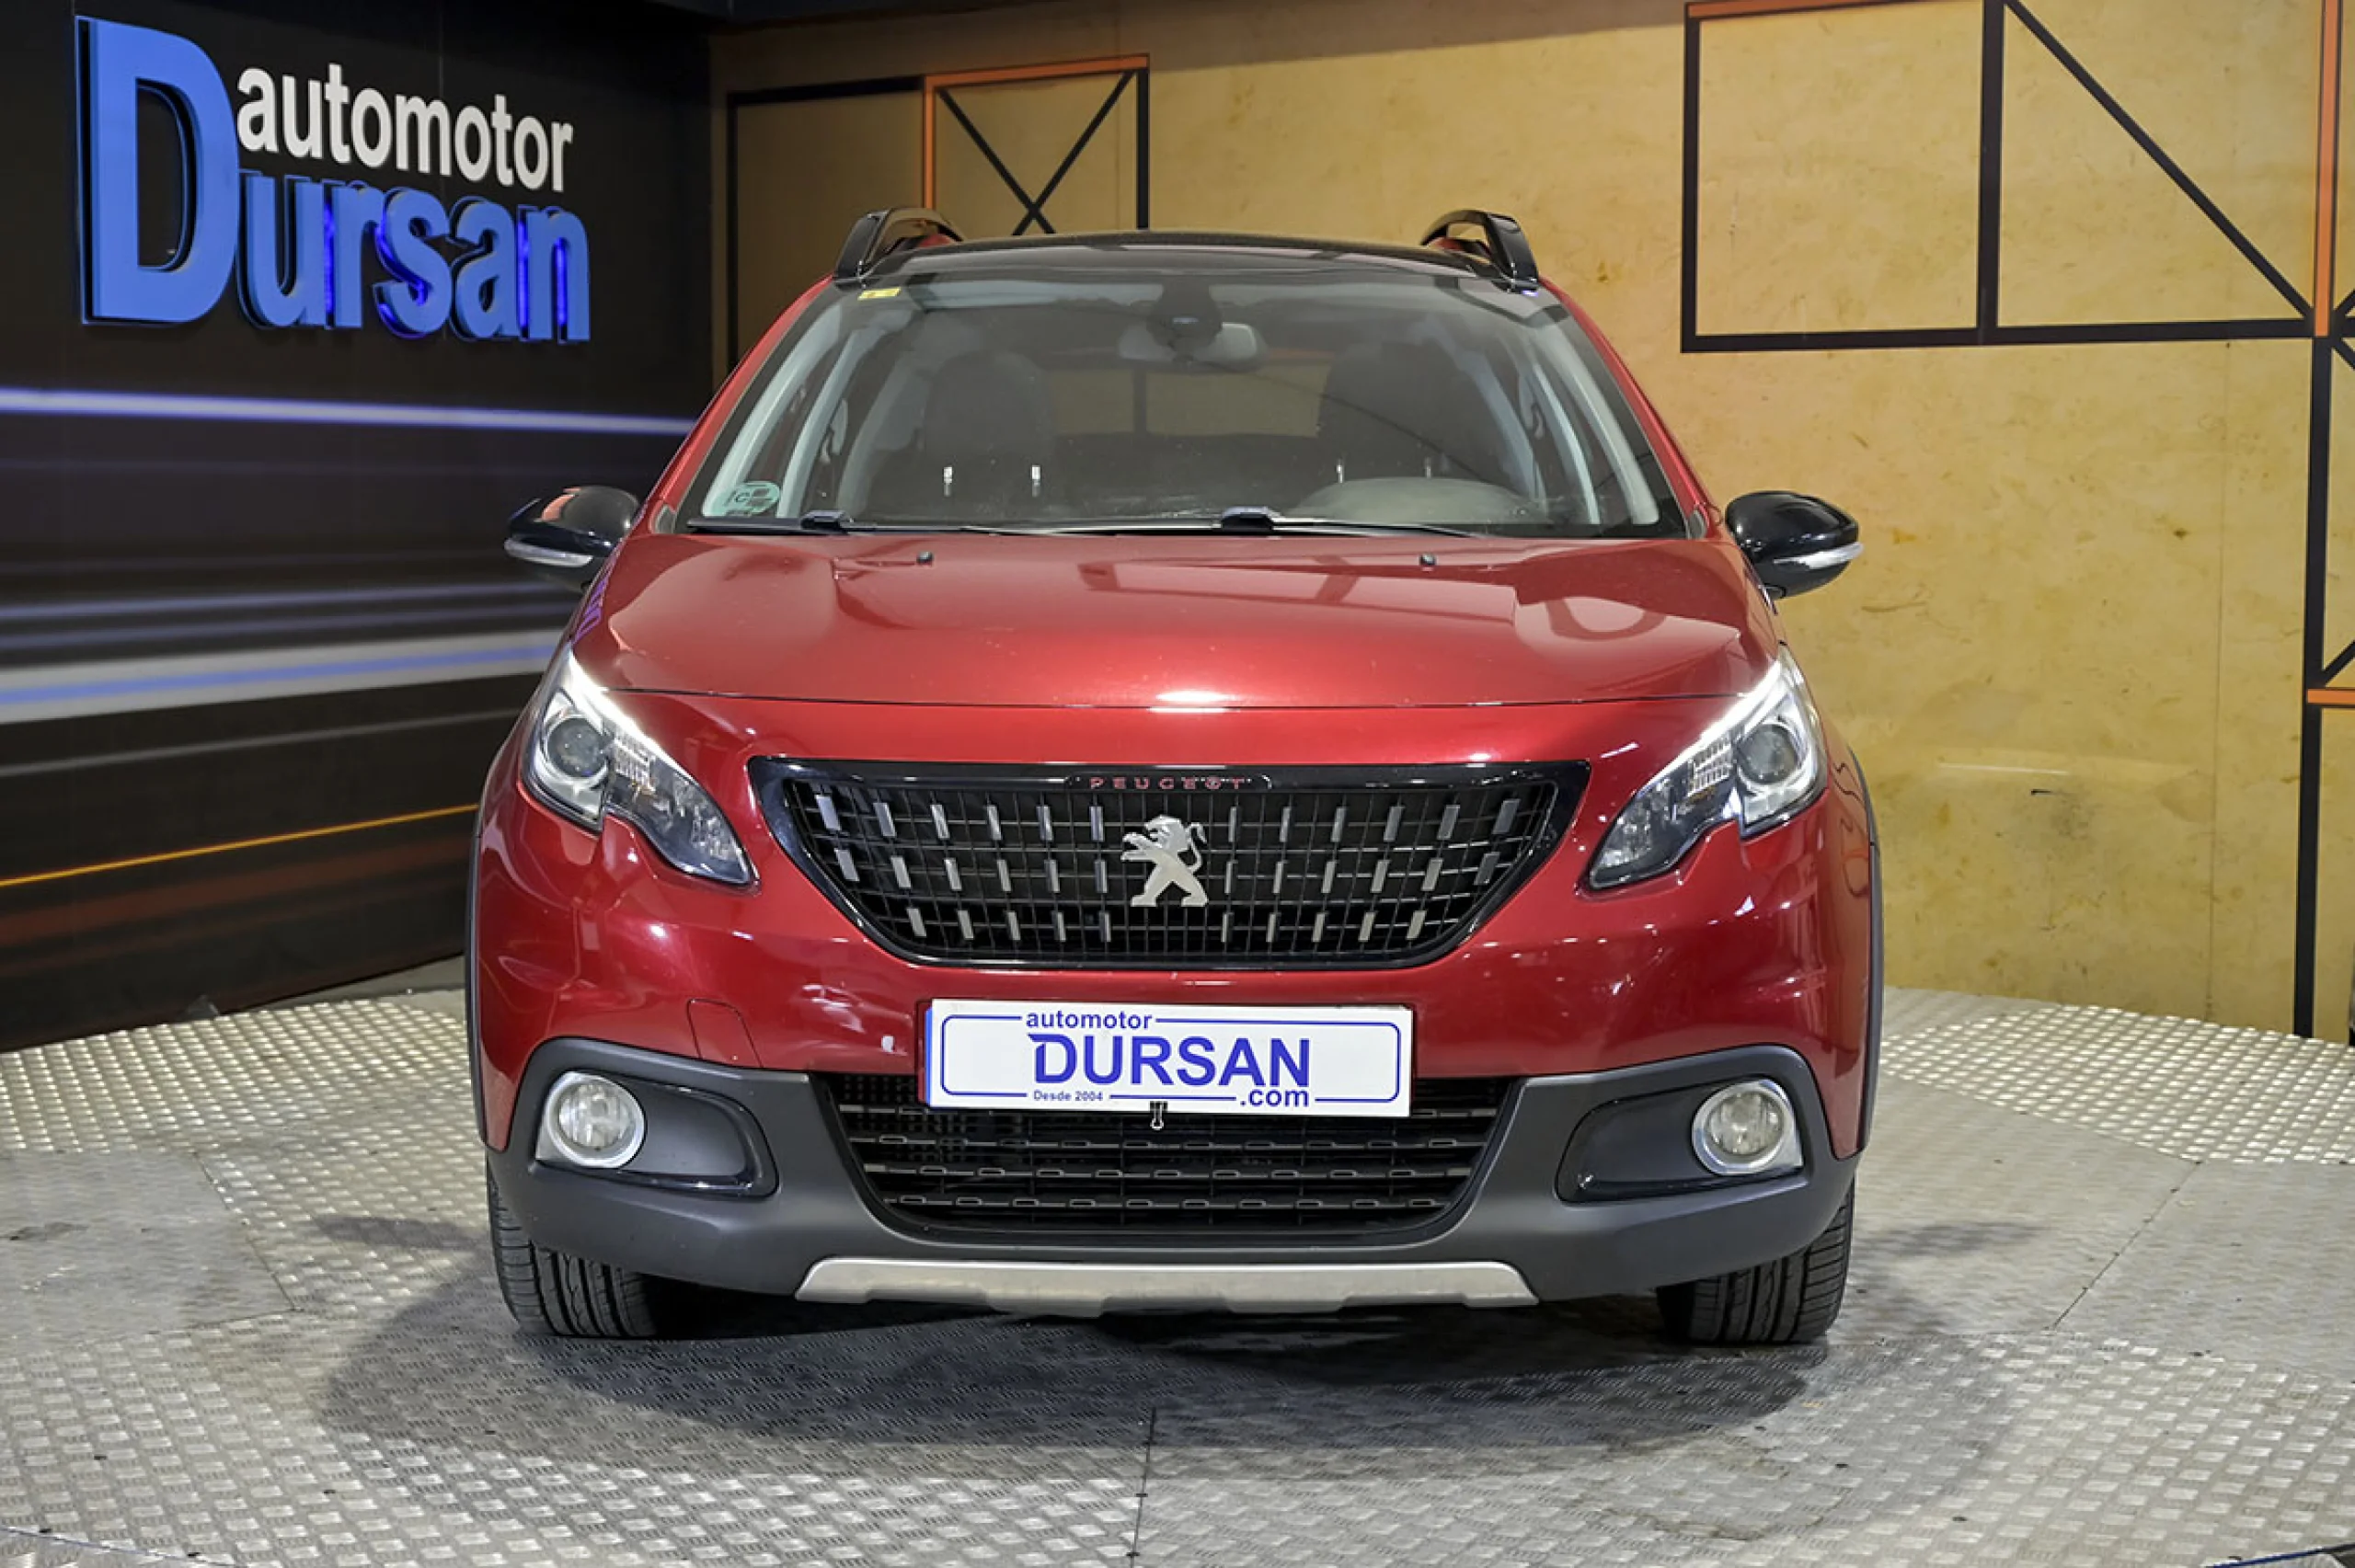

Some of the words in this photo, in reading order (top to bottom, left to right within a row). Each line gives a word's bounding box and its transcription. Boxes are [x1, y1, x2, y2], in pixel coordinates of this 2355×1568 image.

[237, 63, 573, 191] automotor
[75, 16, 590, 344] Dursan
[1090, 776, 1245, 790] PEUGEOT
[1026, 1010, 1153, 1030] automotor
[1028, 1033, 1310, 1088] DURSAN
[1033, 1090, 1072, 1102] Desde
[1074, 1090, 1104, 1102] 2004
[1239, 1089, 1309, 1107] .com
